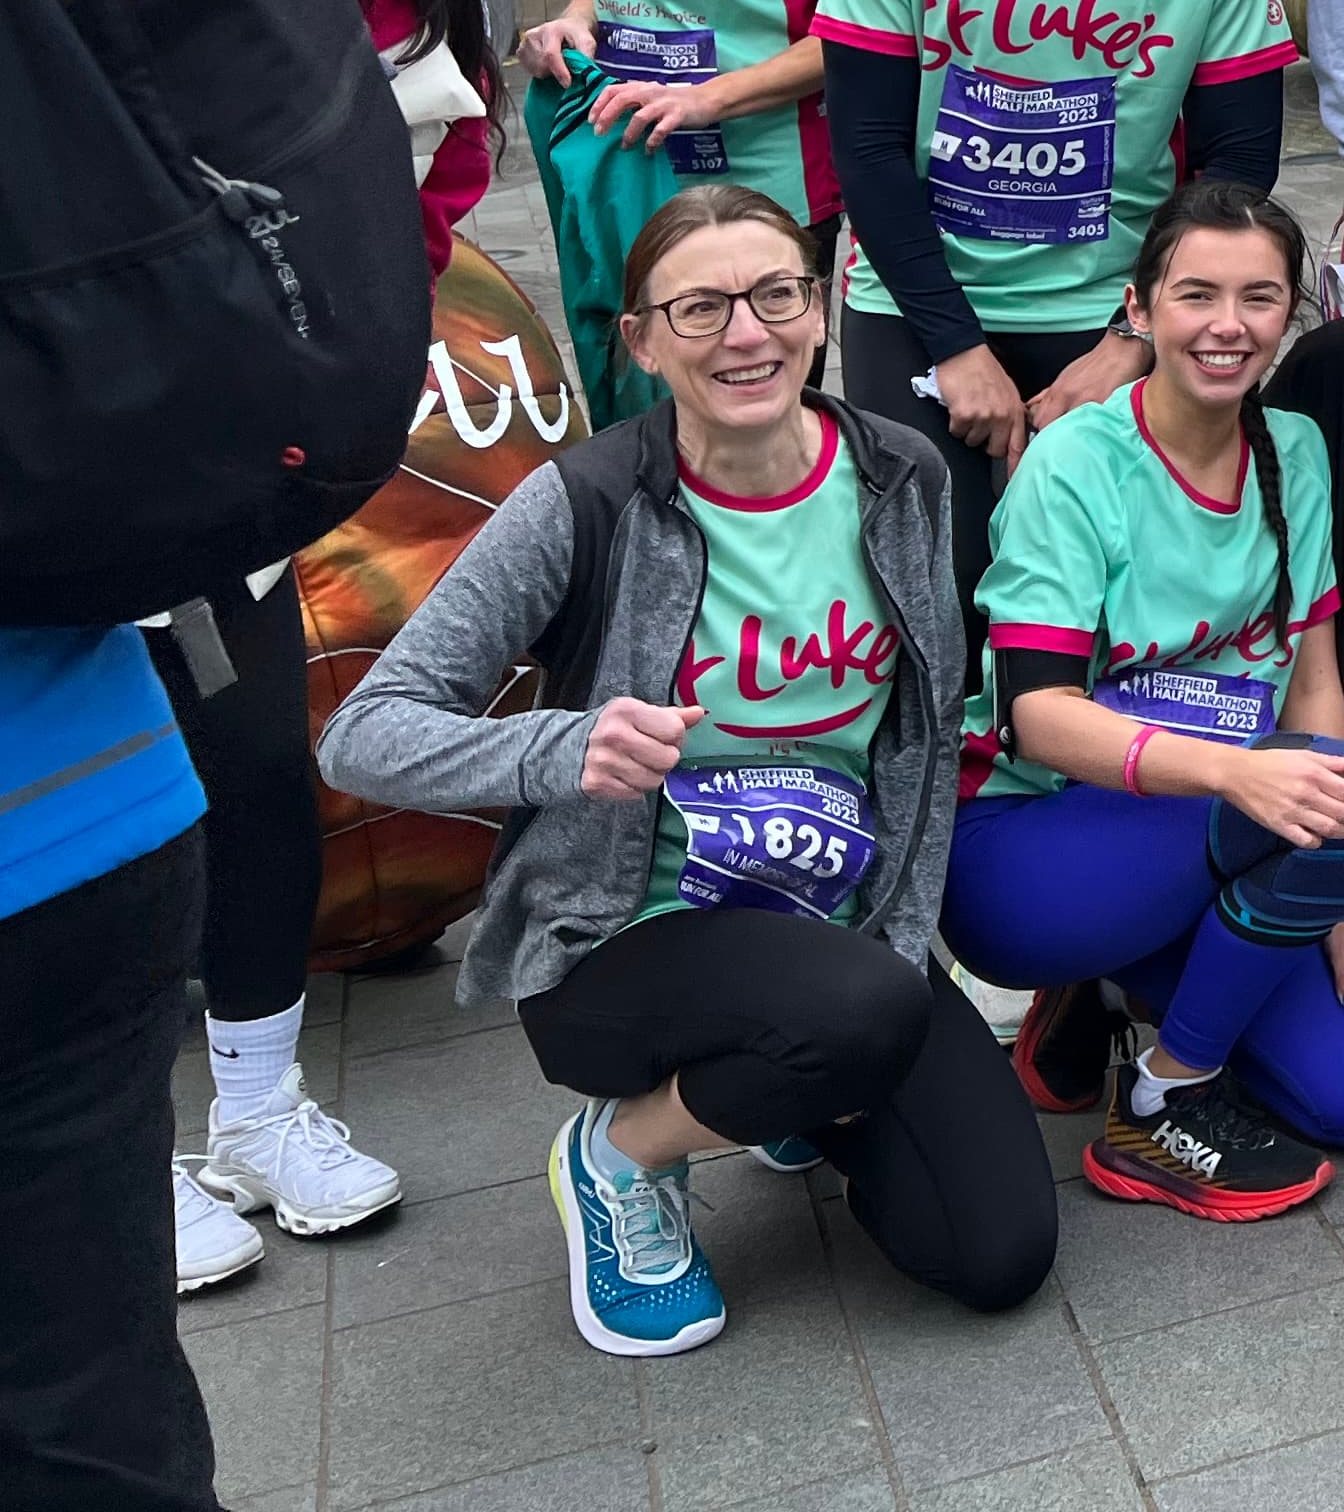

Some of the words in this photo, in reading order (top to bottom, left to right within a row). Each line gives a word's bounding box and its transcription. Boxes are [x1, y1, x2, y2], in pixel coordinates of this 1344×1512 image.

[662, 54, 699, 69] 2023
[993, 87, 1051, 102] SHEFFIELD
[992, 98, 1024, 112] HALF
[1025, 95, 1098, 114] MARATHON
[1058, 106, 1098, 125] 2023
[961, 134, 1087, 178] 3405
[988, 178, 1057, 193] GEORGIA
[1068, 223, 1105, 240] 3405
[1154, 674, 1215, 692] SHEFFIELD
[1153, 688, 1184, 701] HALF
[1185, 689, 1260, 713] MARATHON
[1216, 711, 1258, 730] 2023
[740, 769, 813, 782] SHEFFIELD
[782, 778, 858, 810] MARATHON
[821, 798, 860, 825] 2023
[1150, 1118, 1223, 1179] HOKA
